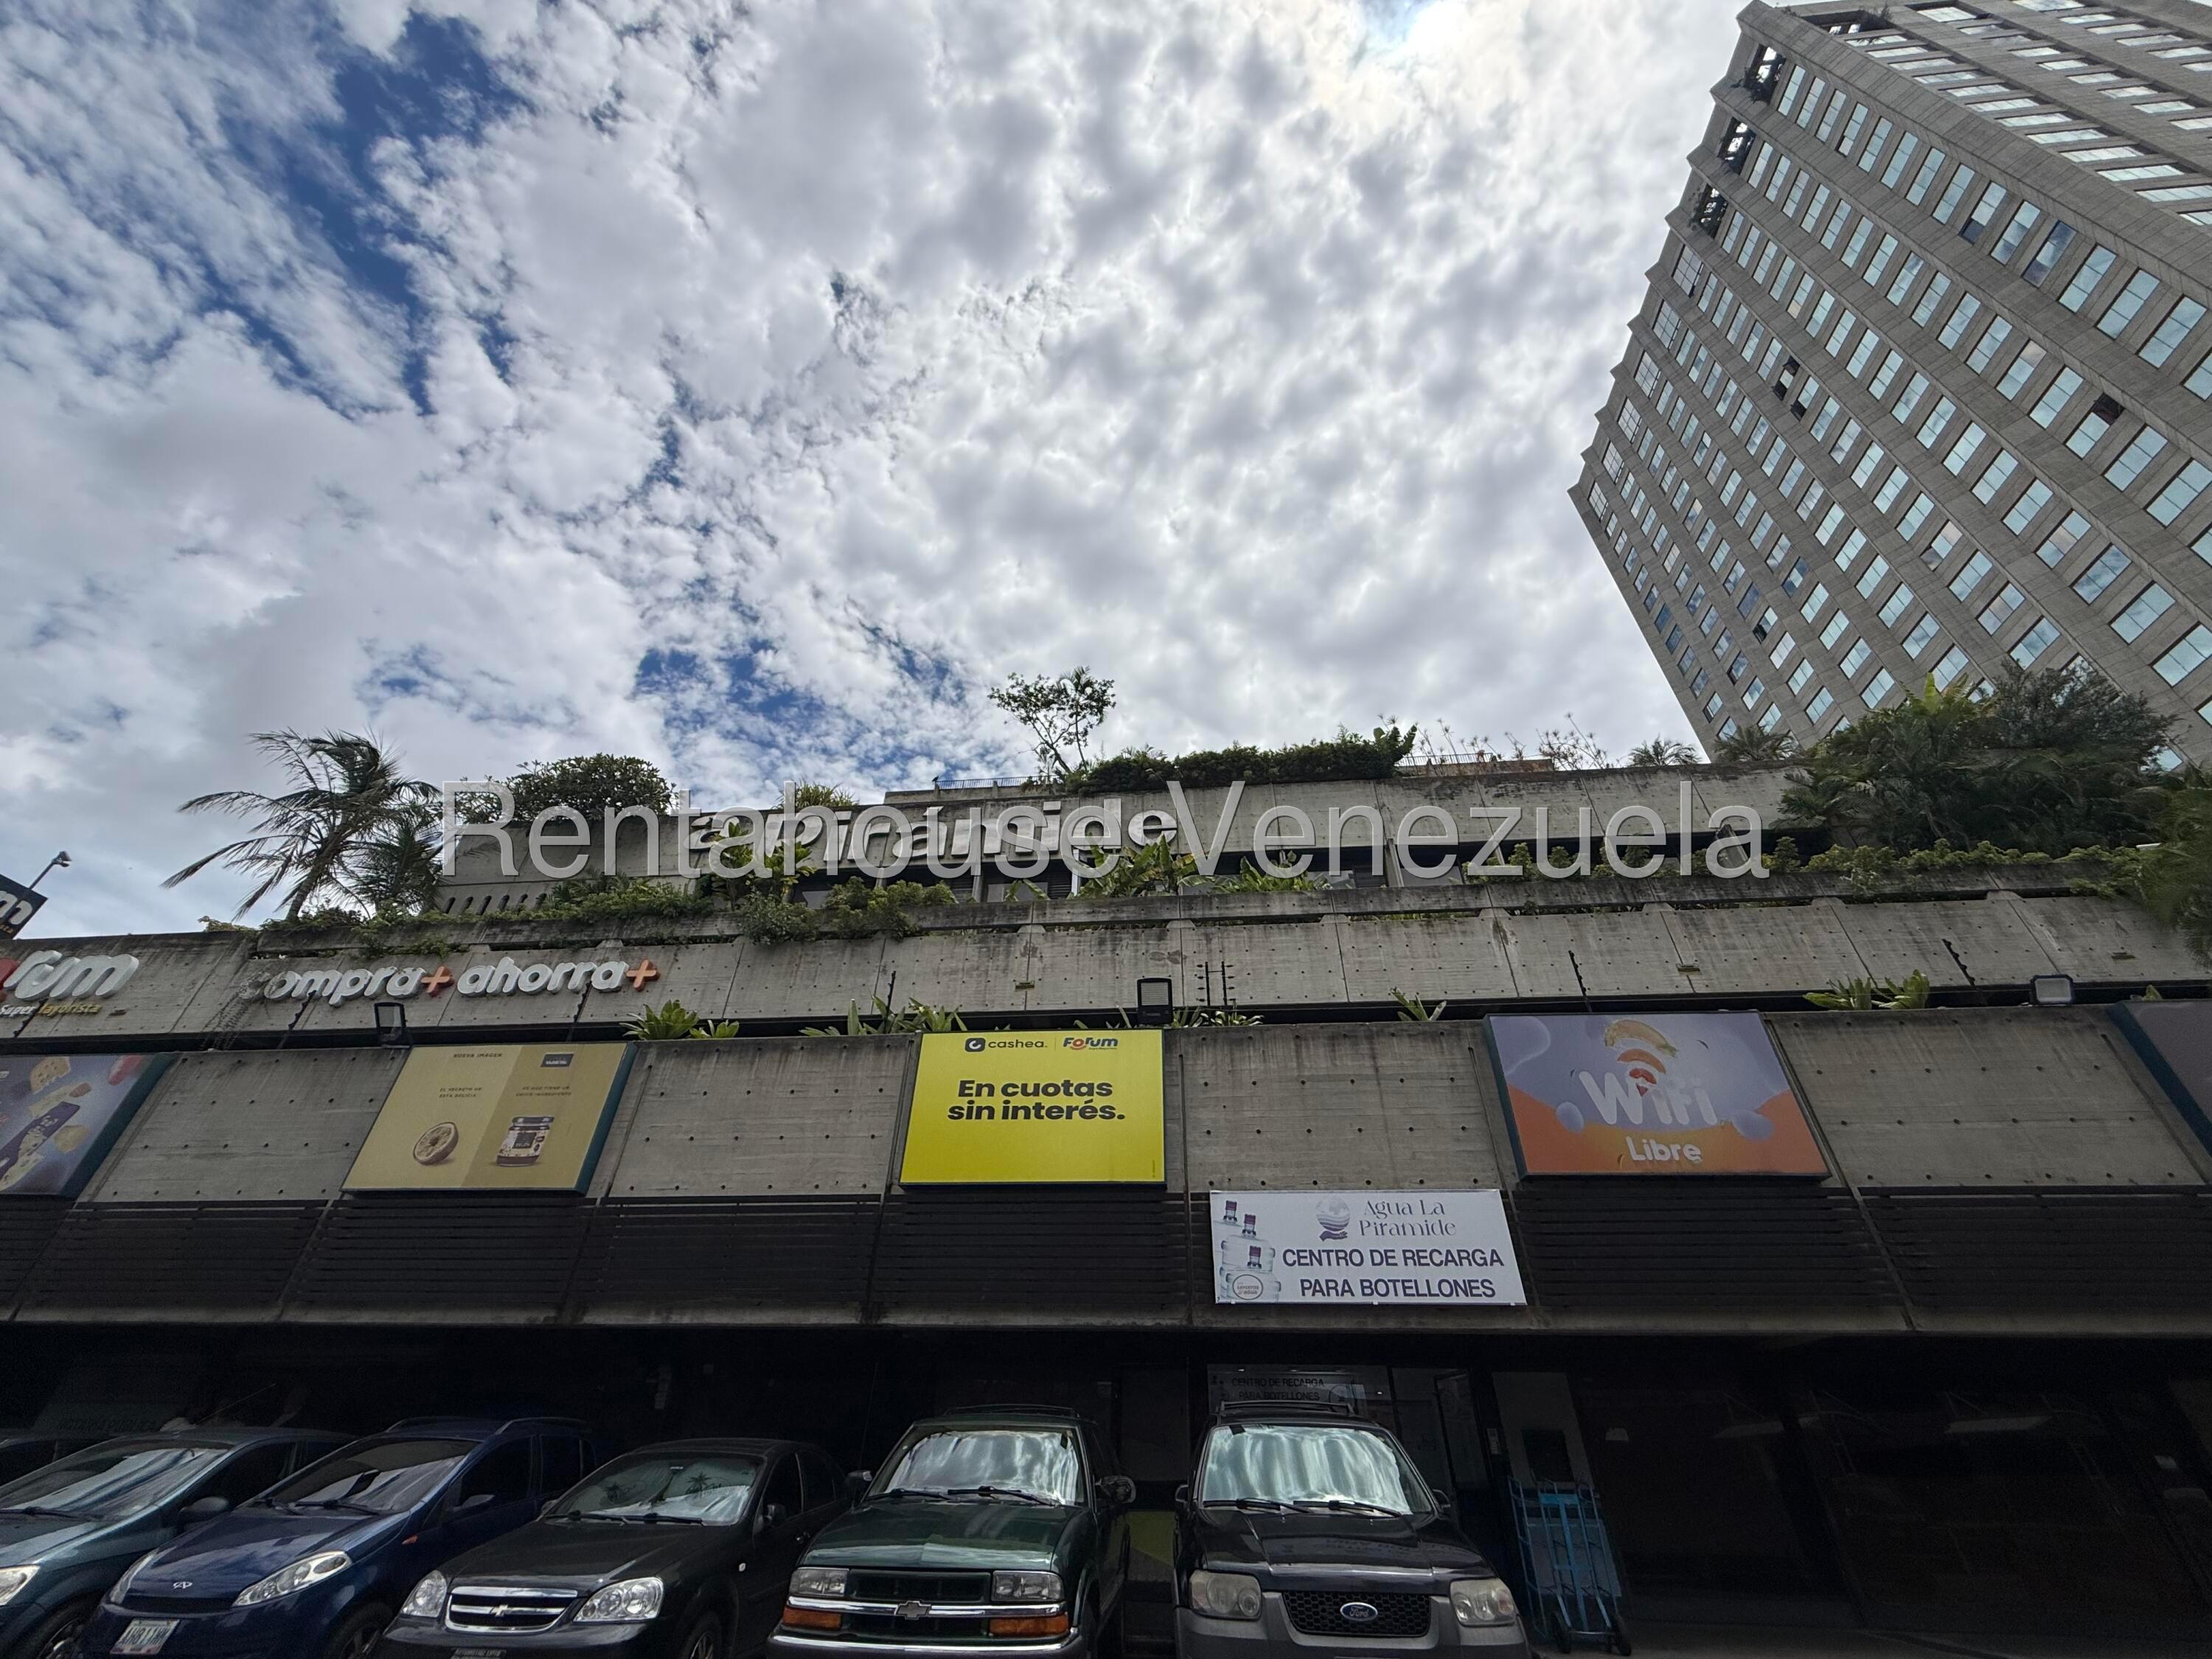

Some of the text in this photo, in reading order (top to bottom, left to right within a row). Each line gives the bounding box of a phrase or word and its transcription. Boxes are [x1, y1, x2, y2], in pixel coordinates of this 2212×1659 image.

[38, 1004, 102, 1017] ayorista
[1063, 1037, 1119, 1050] Forum
[958, 1079, 1113, 1097] En cuotas
[947, 1099, 1126, 1120] sin interés.
[1626, 1136, 1703, 1163] Libre
[1364, 1199, 1446, 1219] Agua La
[1359, 1219, 1457, 1237] Piramide
[1282, 1249, 1505, 1267] CENTRO DE RECARGA
[1300, 1279, 1496, 1298] PARA BOTELLONES
[1349, 1605, 1369, 1618] Ford
